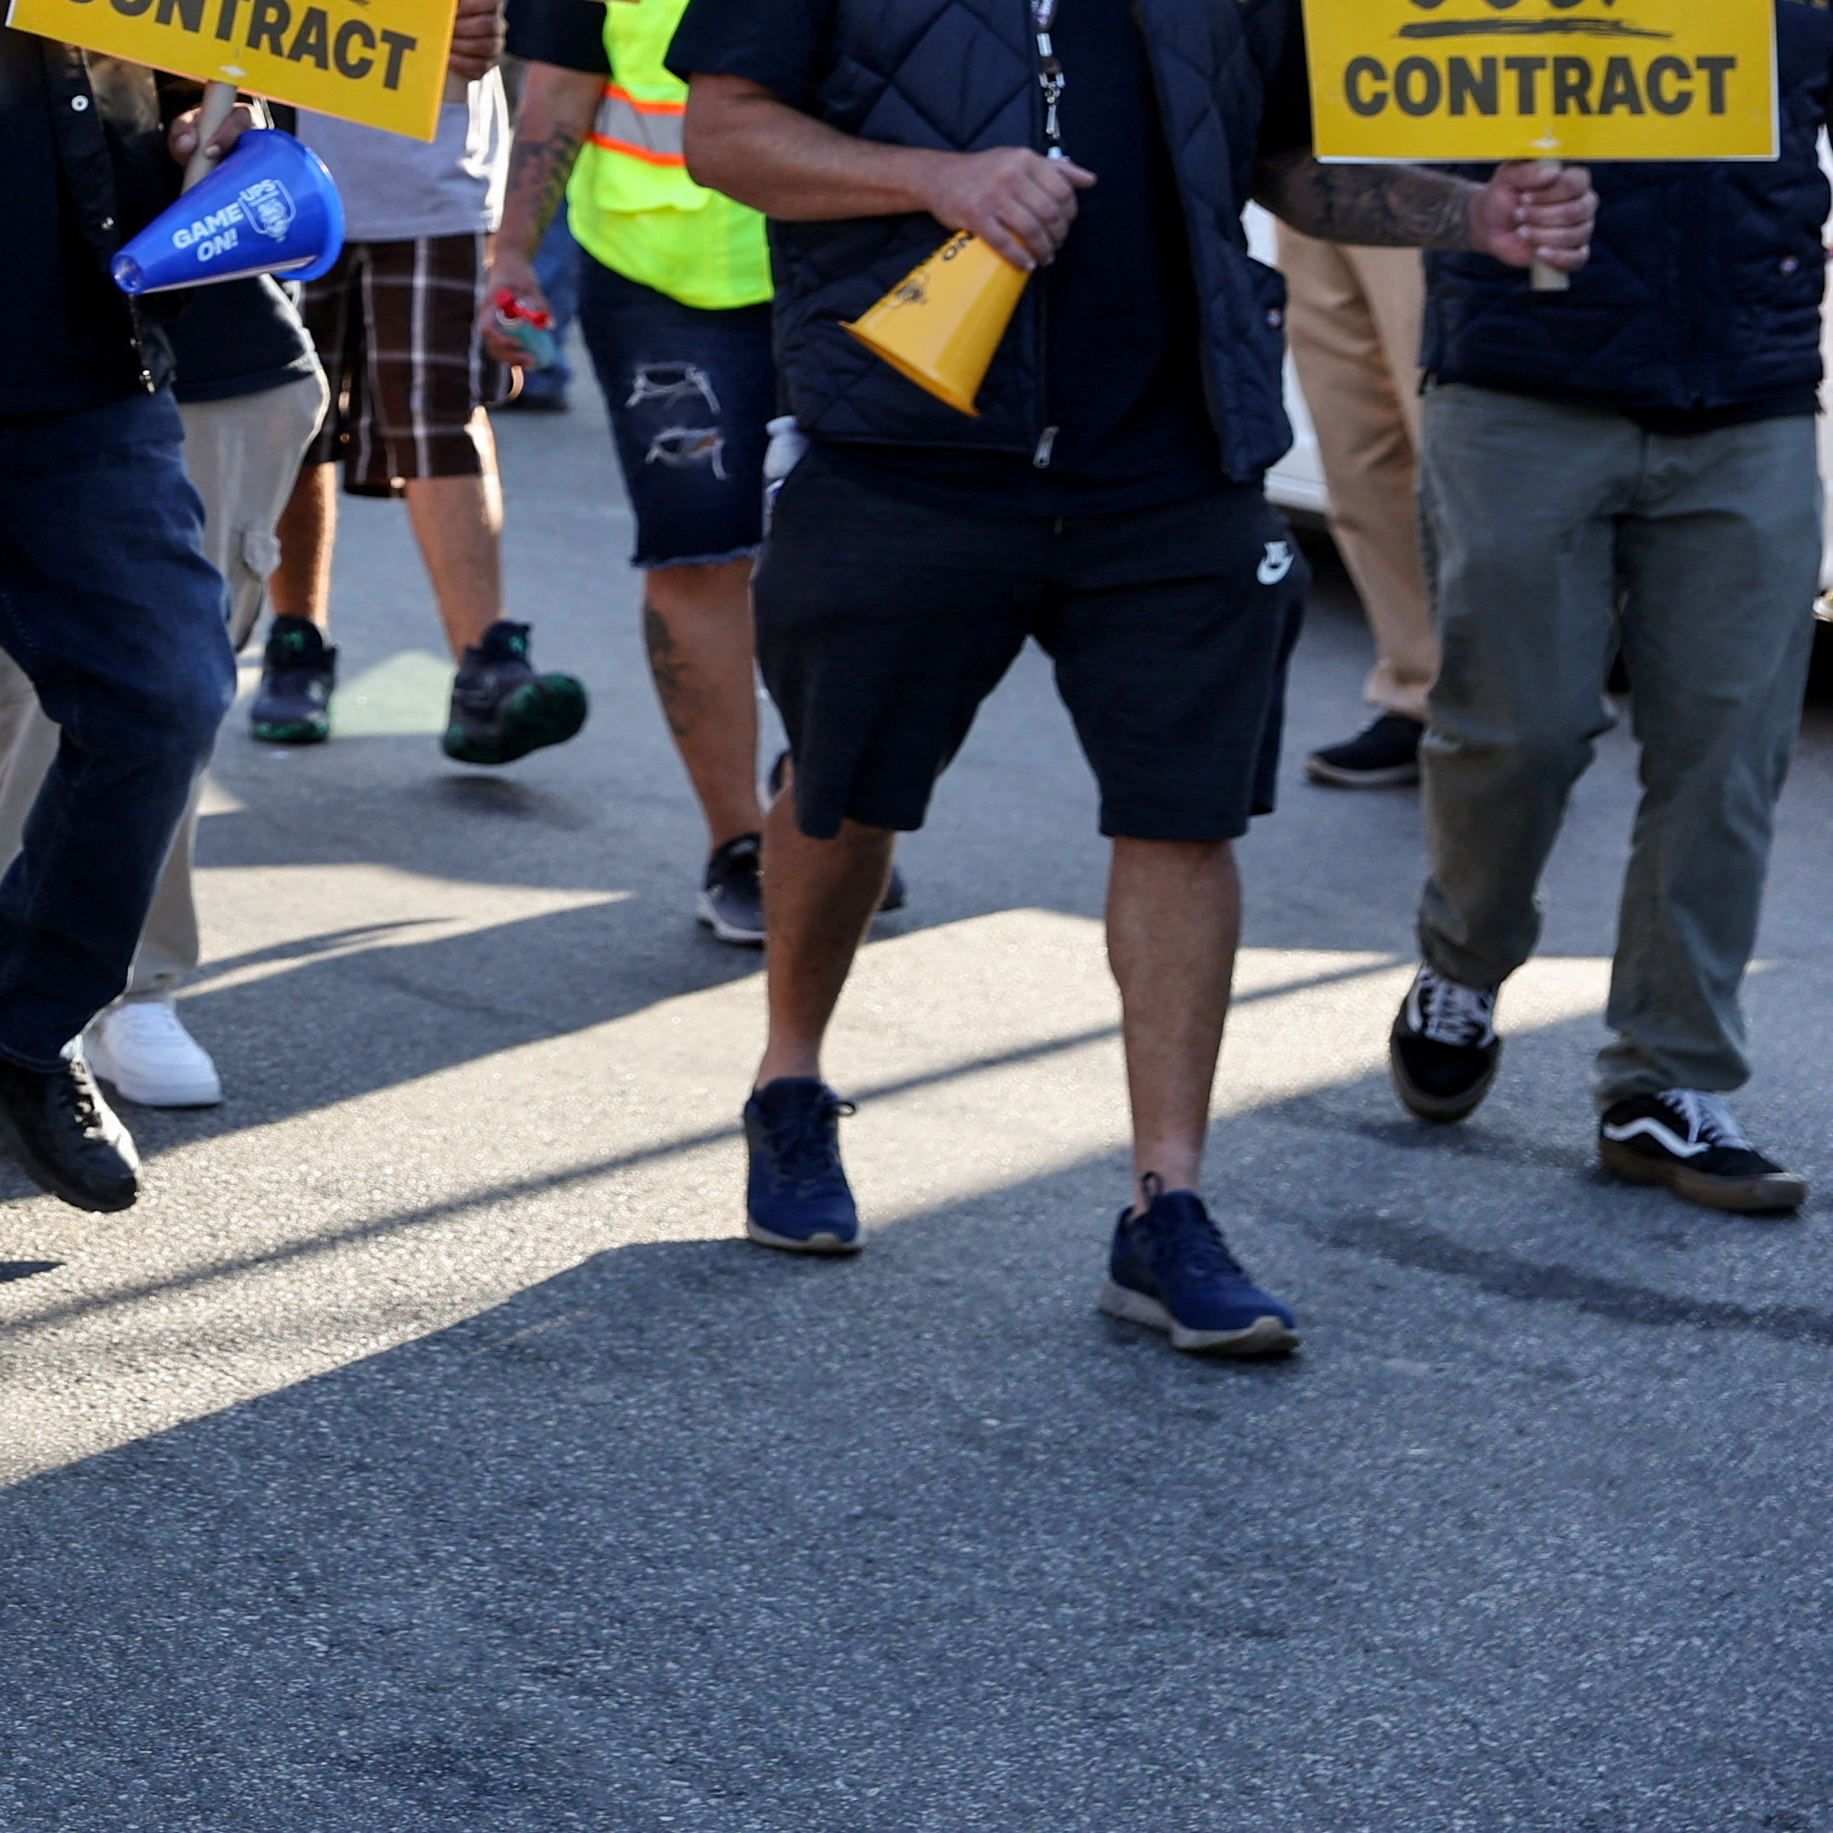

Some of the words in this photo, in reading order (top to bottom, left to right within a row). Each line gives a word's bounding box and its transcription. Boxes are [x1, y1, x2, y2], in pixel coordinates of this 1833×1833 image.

[1345, 57, 1736, 116] CONTRACT
[240, 179, 277, 202] UPS
[172, 200, 244, 249] GAME
[196, 228, 238, 262] ON!
